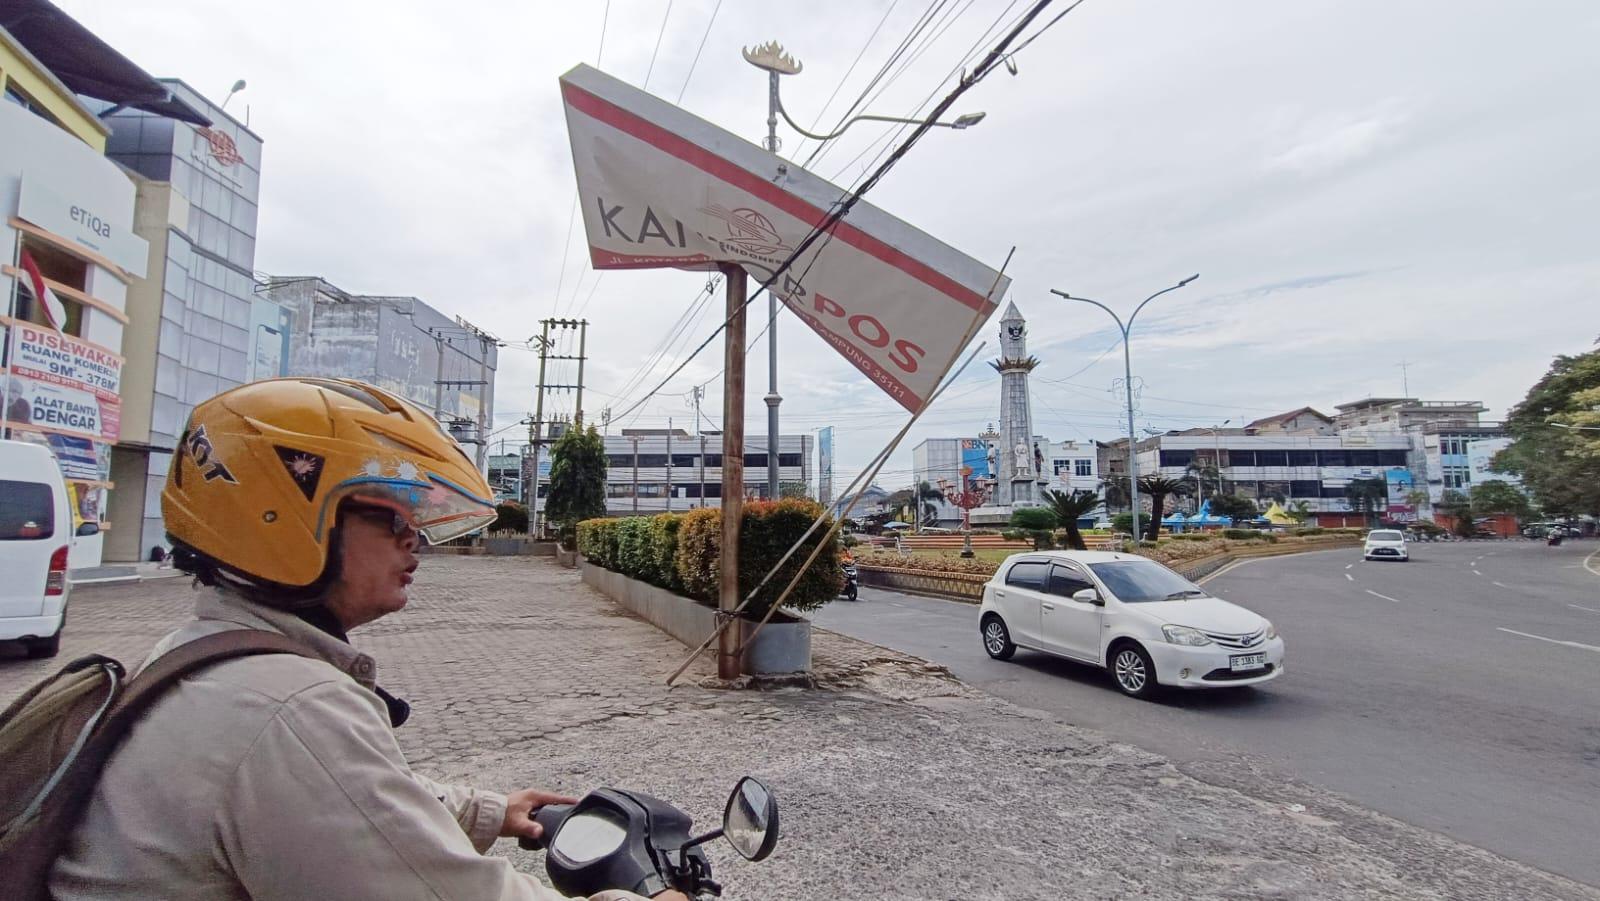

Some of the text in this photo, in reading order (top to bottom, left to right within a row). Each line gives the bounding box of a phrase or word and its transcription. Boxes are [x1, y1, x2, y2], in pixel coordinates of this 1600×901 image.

[814, 293, 926, 373] POS
[20, 342, 71, 363] RUANG
[22, 328, 120, 370] DISEWAKAN
[873, 369, 905, 397] 35111
[32, 407, 96, 430] DENGAR
[34, 395, 97, 417] ALAT BANTU
